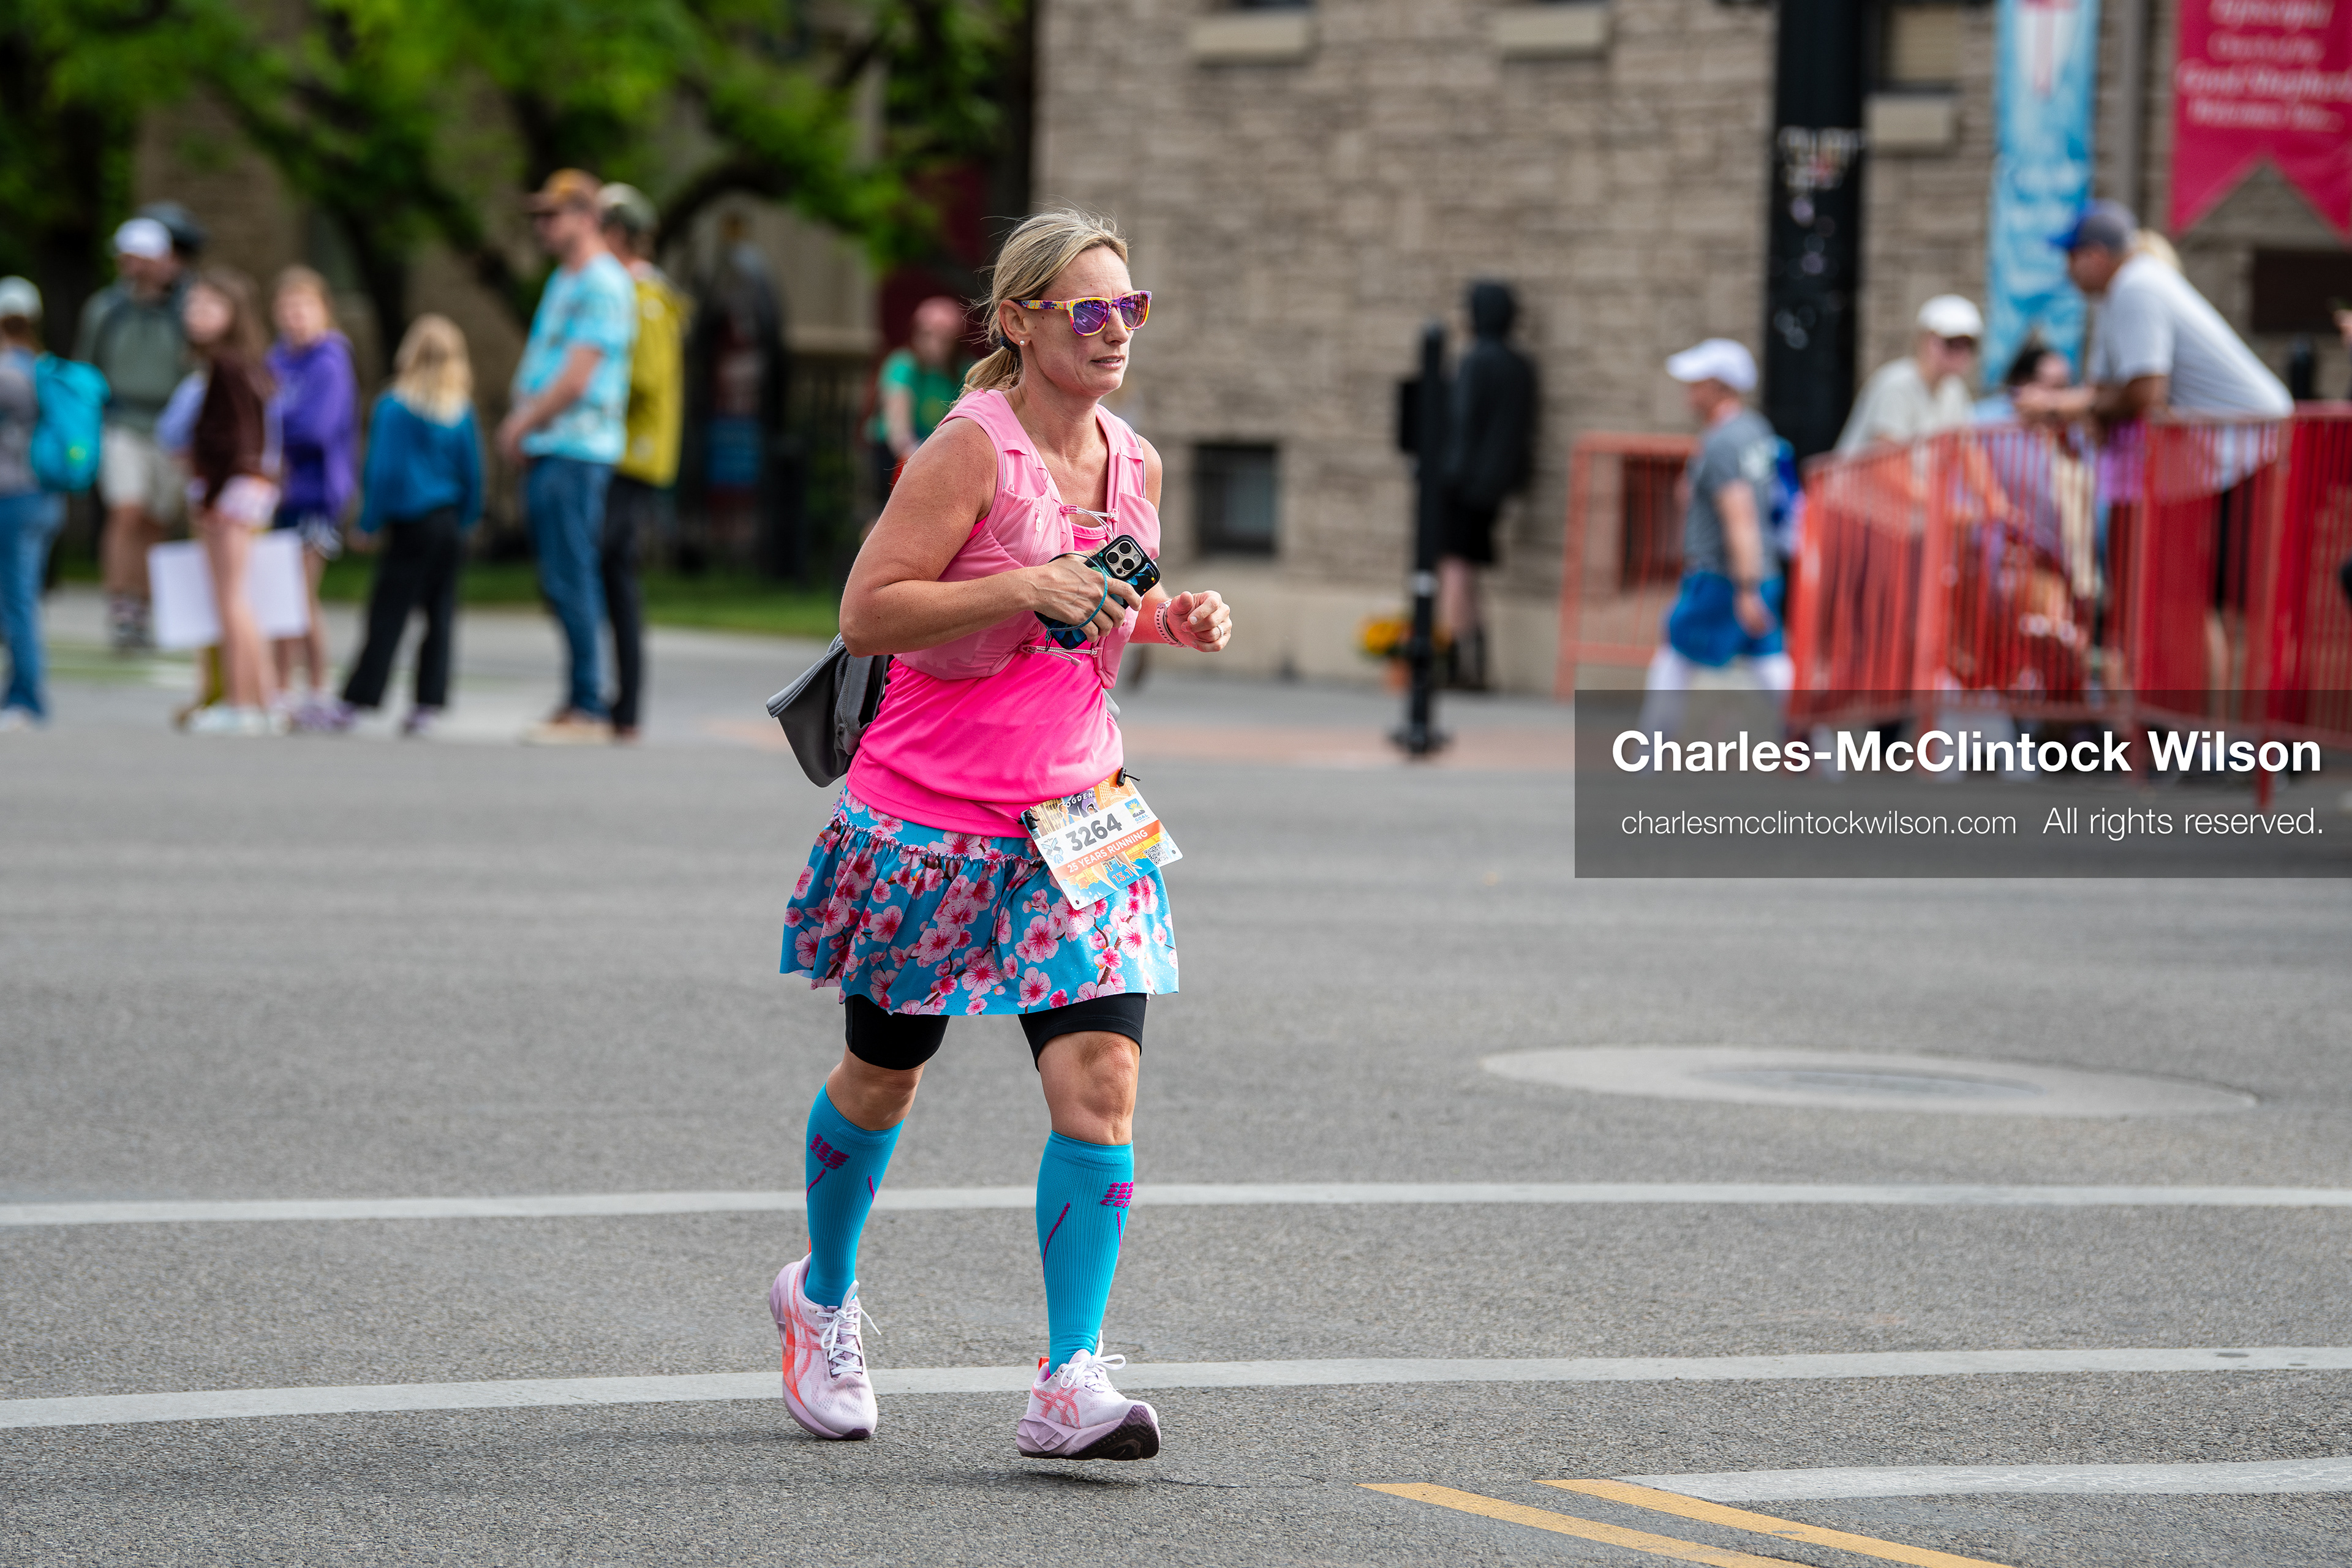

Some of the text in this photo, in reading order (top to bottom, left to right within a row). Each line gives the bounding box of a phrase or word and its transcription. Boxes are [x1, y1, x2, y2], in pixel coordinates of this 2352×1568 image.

[1066, 791, 1093, 808] OGDEN
[1065, 813, 1123, 851] 3264
[1067, 829, 1148, 873] 25 YEARS RUNNING
[1112, 869, 1134, 883] 13.1
